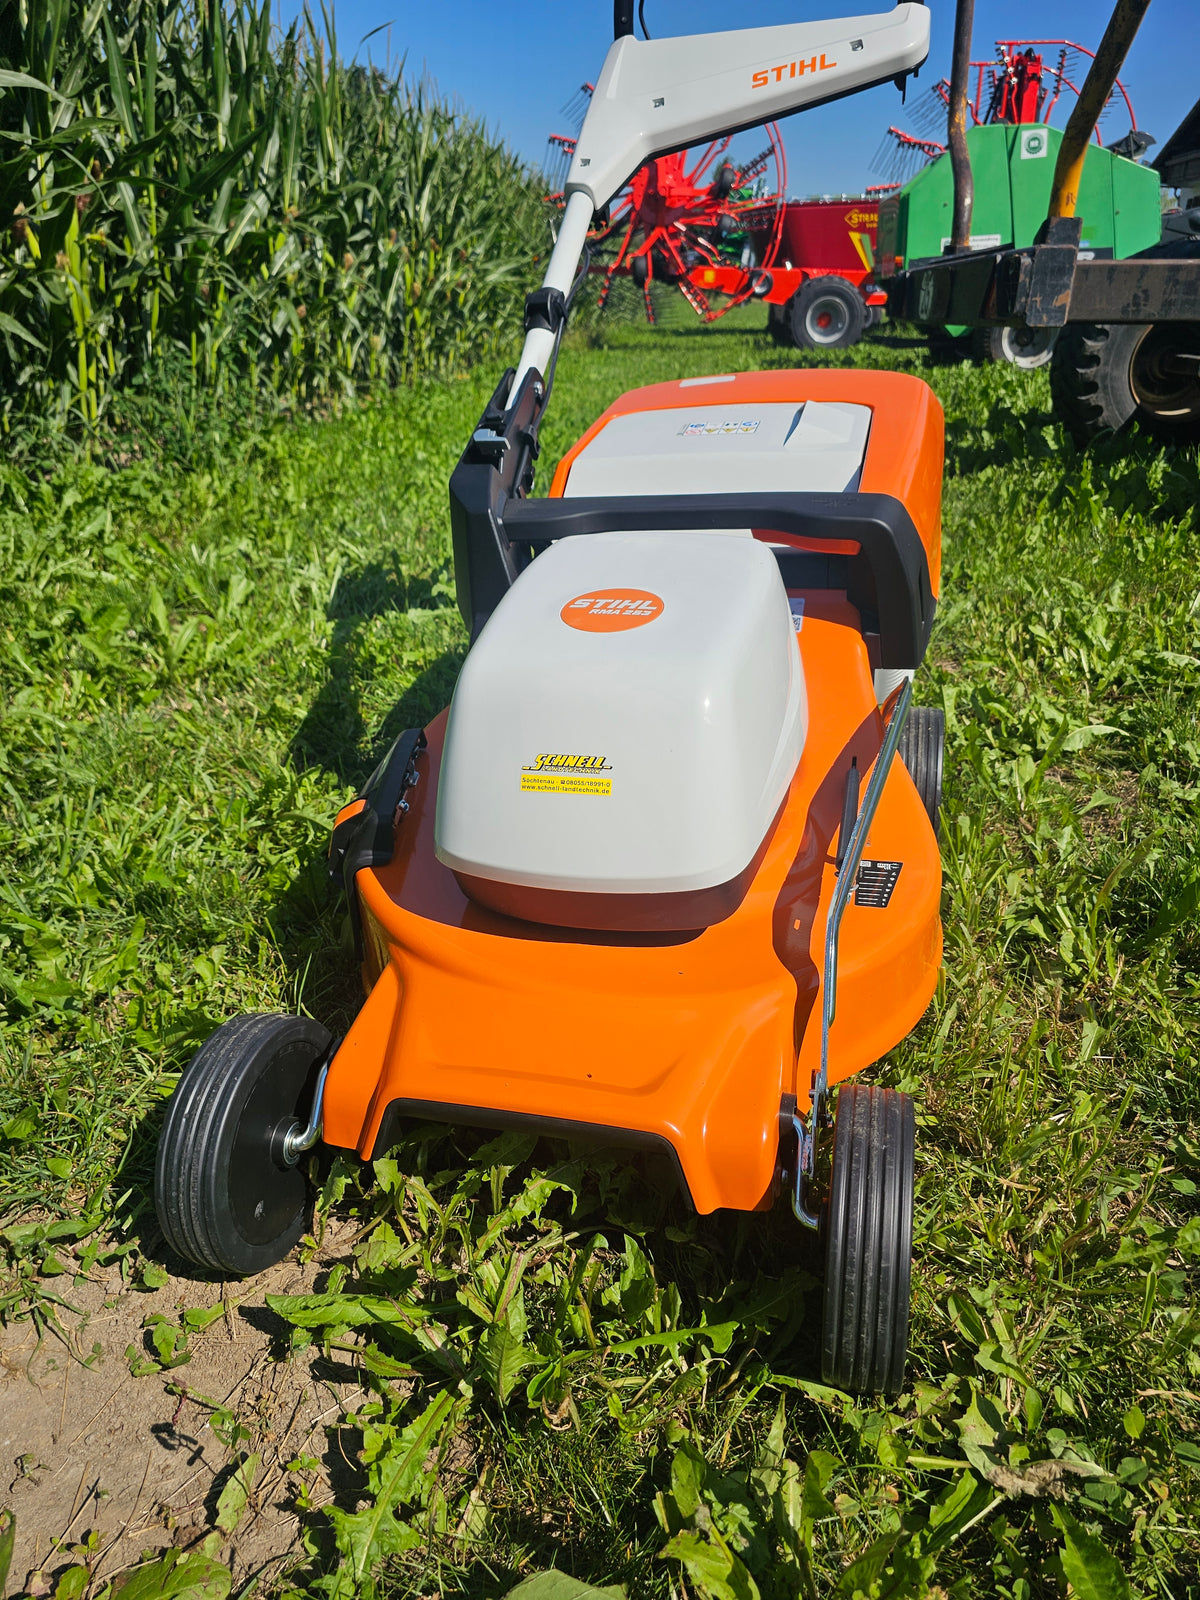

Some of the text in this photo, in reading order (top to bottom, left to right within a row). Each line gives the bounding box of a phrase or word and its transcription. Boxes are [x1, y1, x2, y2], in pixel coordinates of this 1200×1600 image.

[752, 53, 837, 89] STIHL
[569, 598, 658, 610] STIHL
[525, 753, 609, 771] SCHNELL
[521, 784, 610, 794] www.schnell-landtechnik.de
